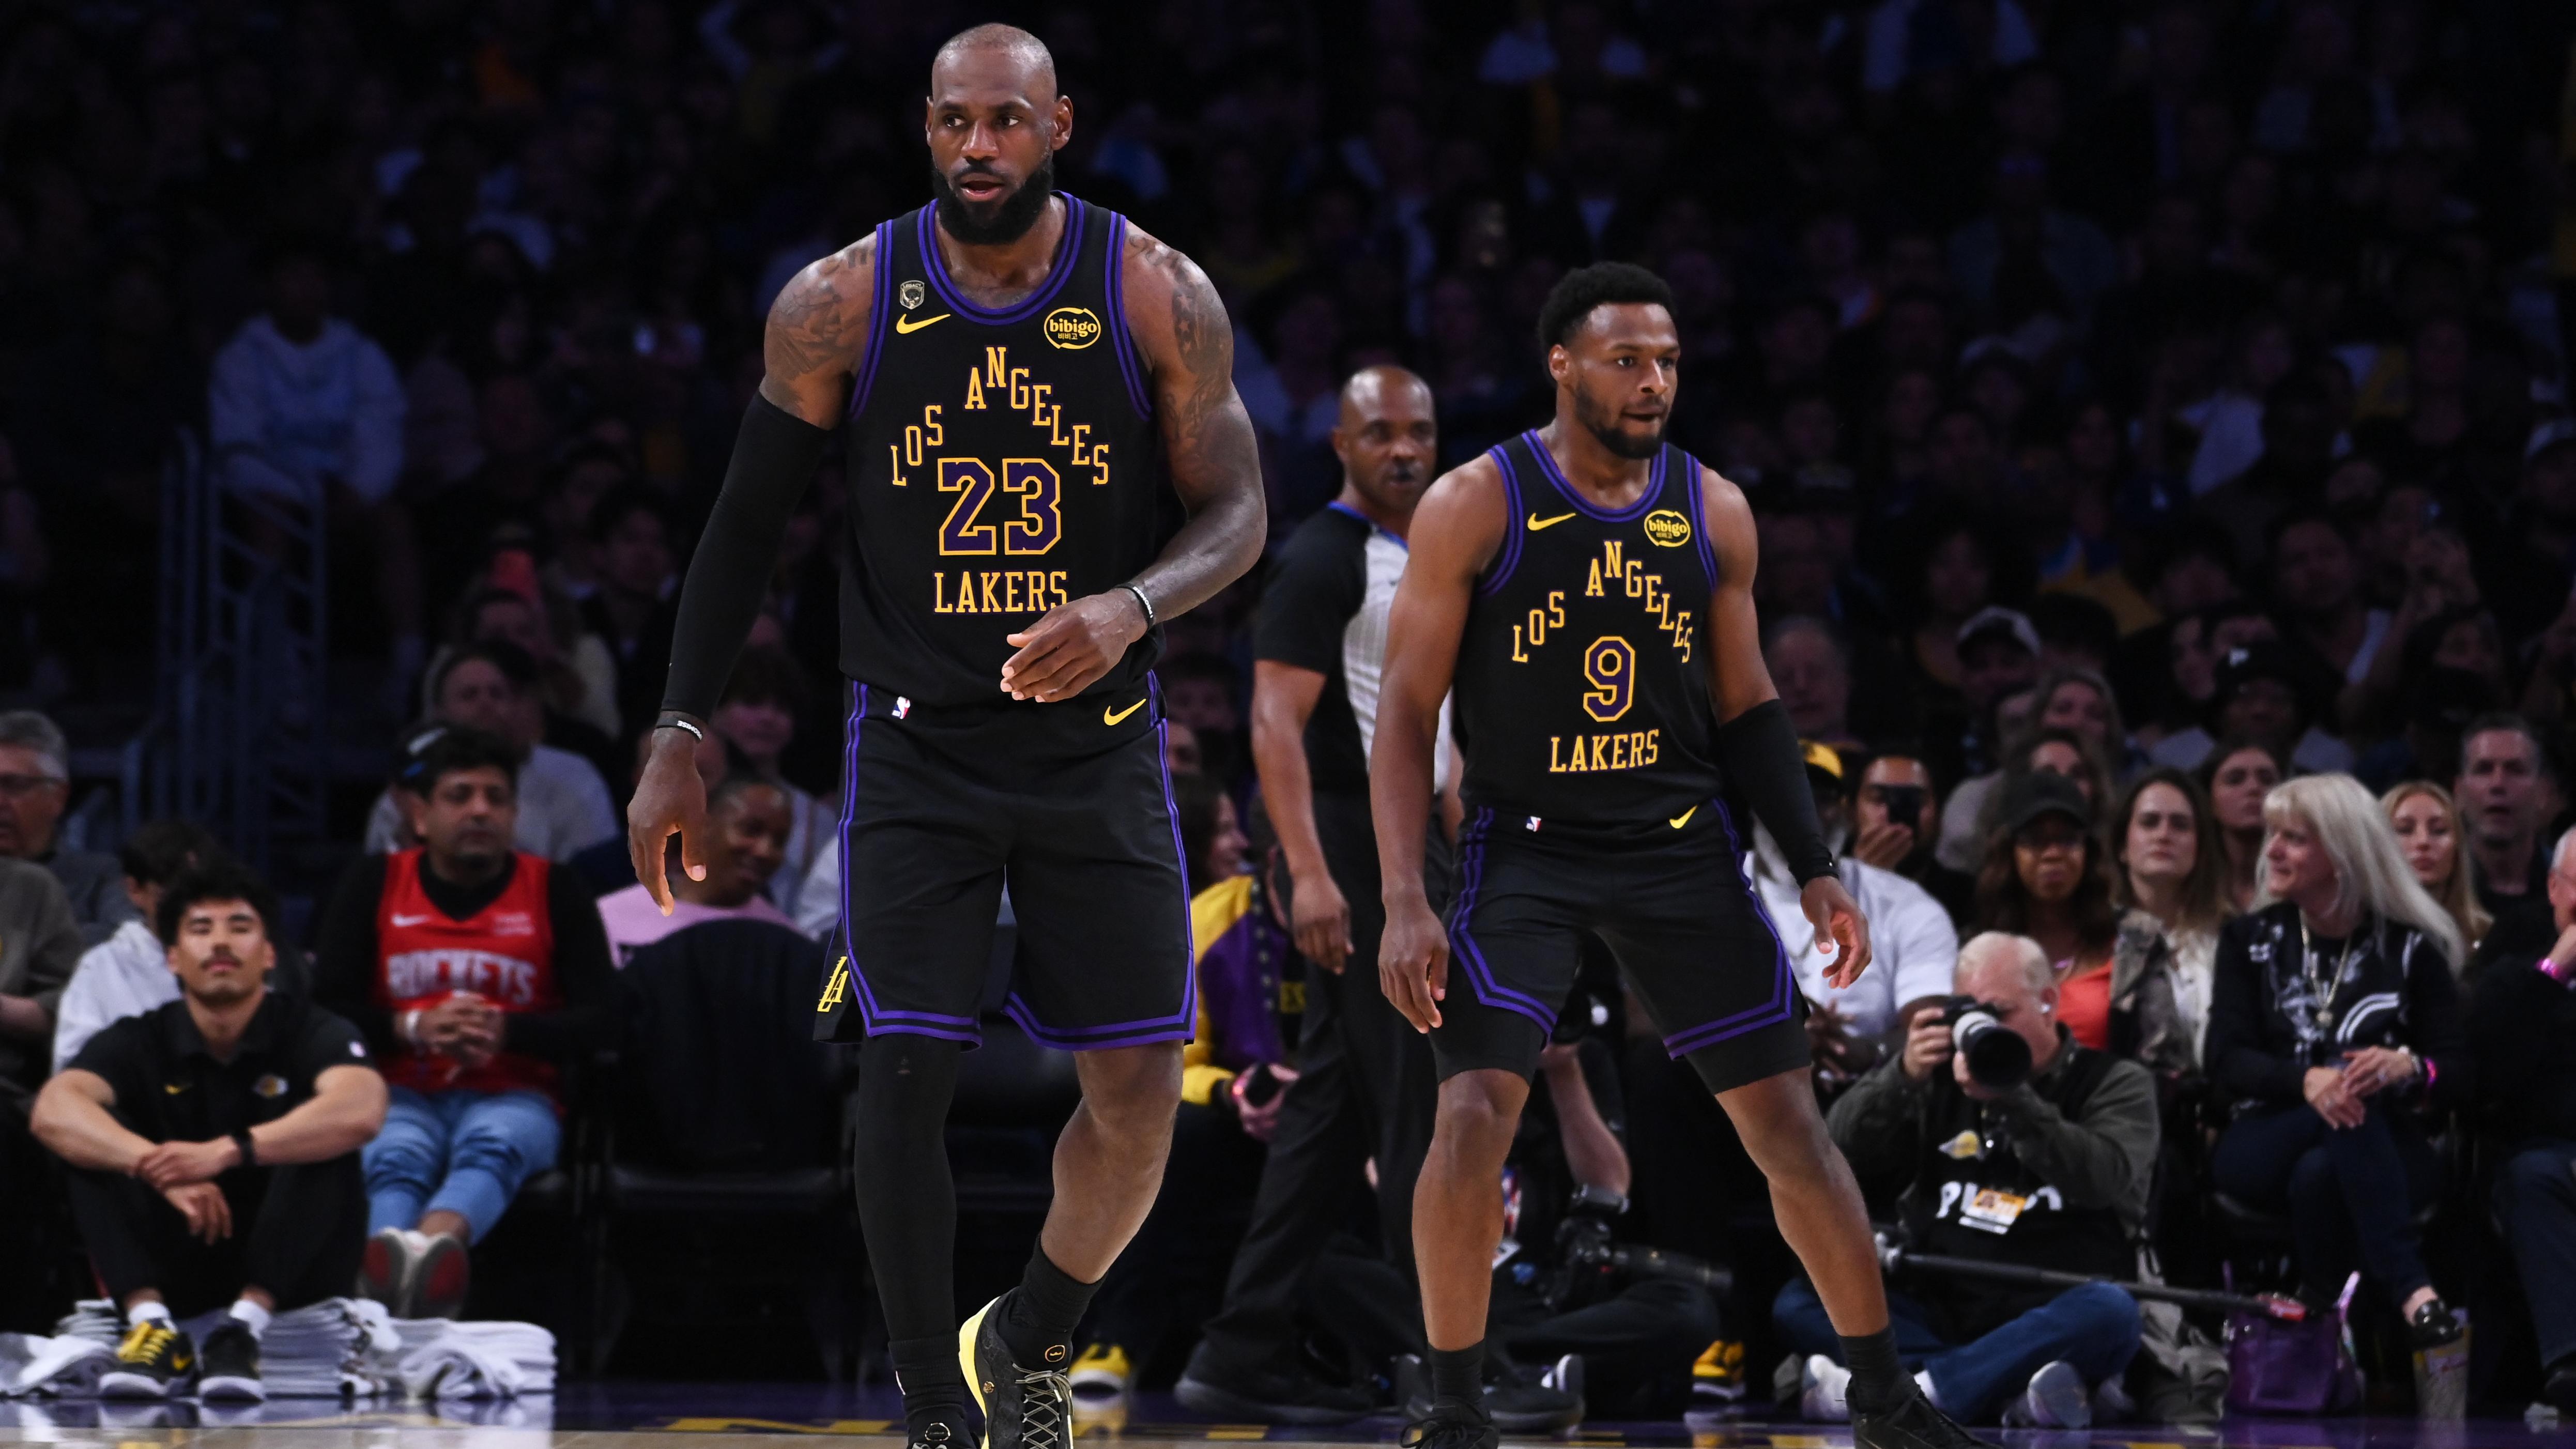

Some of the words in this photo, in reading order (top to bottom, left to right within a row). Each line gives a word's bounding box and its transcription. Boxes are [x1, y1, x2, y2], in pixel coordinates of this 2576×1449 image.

[1049, 318, 1097, 337] bibigo
[891, 405, 943, 486] LOS
[964, 347, 1109, 485] ANGELES
[937, 457, 1062, 556] 23
[1648, 519, 1688, 537] bibigo
[934, 571, 1068, 613] LAKERS
[1512, 591, 1565, 663] LOS
[1585, 541, 1693, 664] ANGELES
[1583, 636, 1636, 722] 9
[1550, 729, 1659, 773] LAKERS
